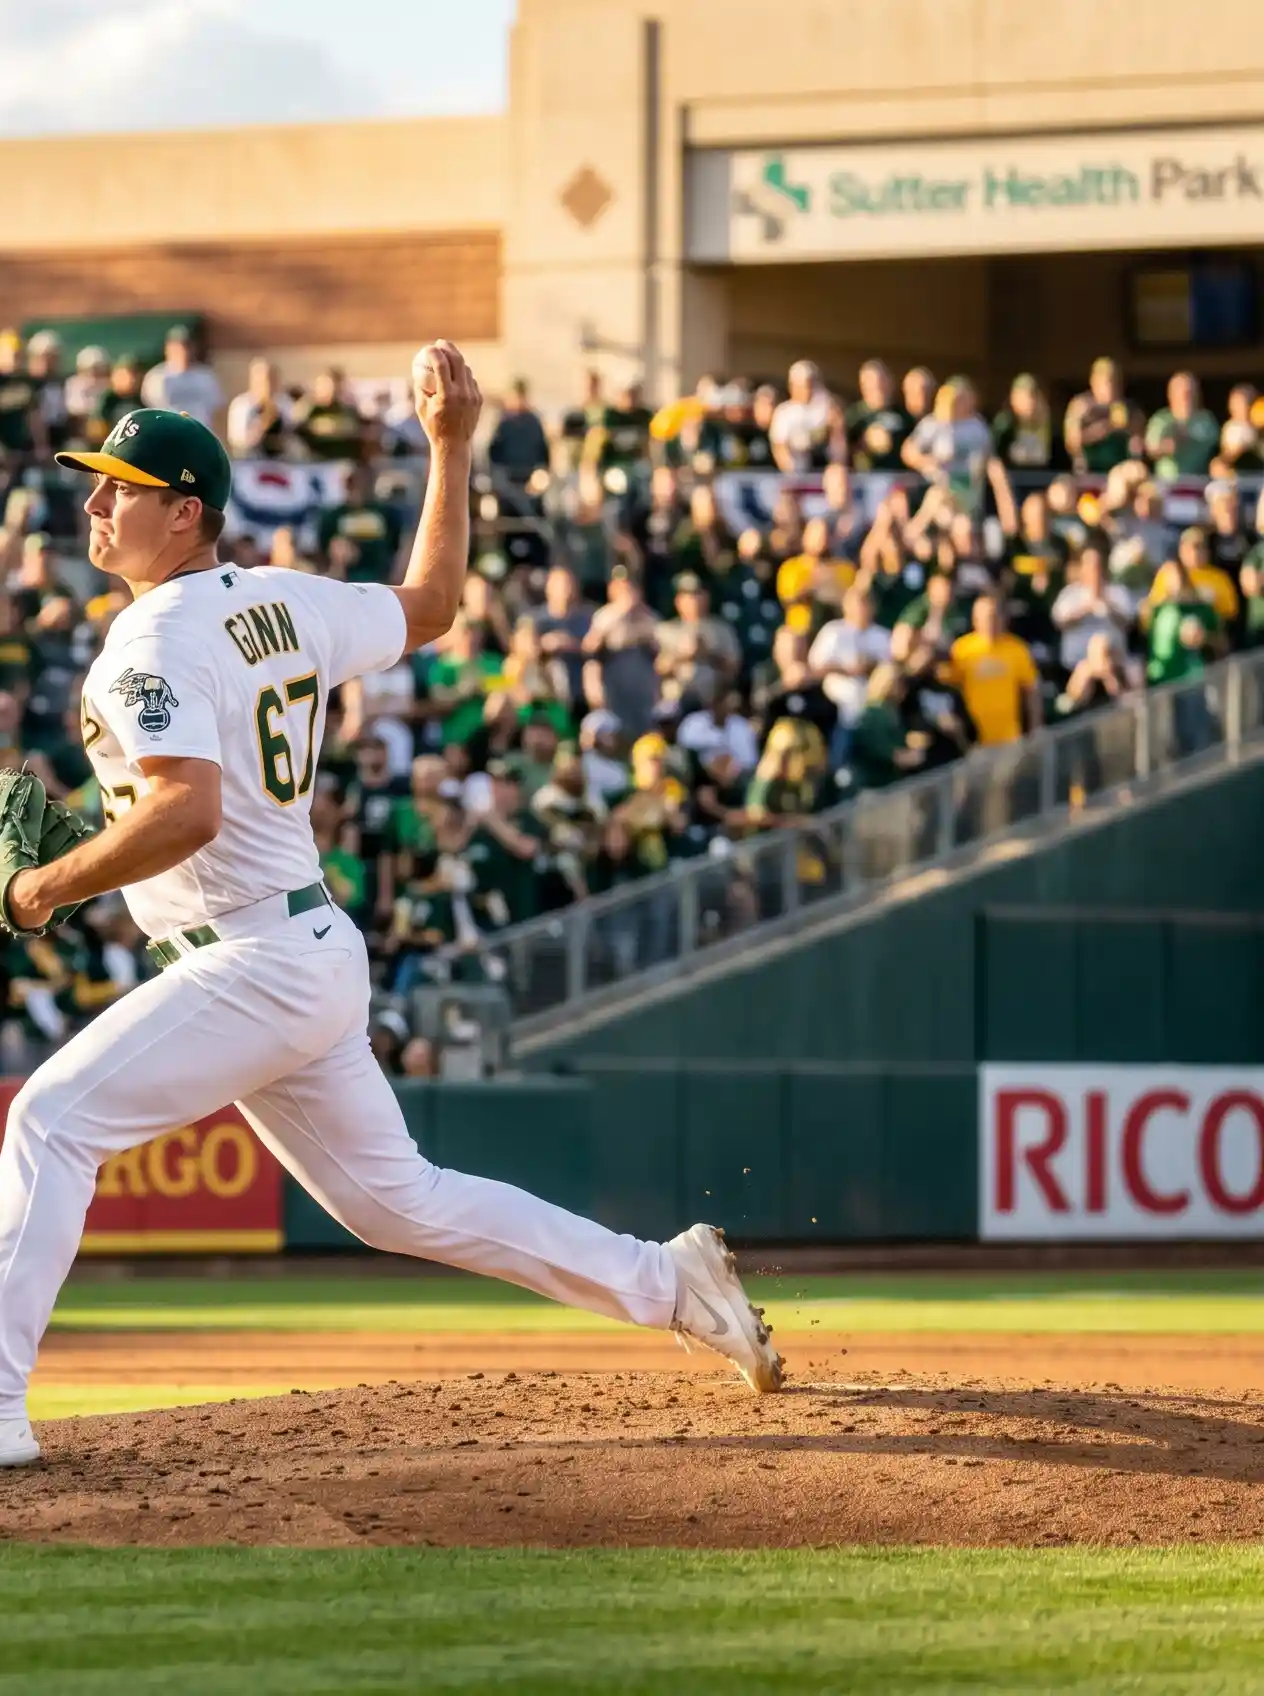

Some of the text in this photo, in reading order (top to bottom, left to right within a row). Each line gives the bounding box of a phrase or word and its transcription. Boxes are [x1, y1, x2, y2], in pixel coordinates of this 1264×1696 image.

[827, 154, 1264, 216] Sutter Health Park
[224, 601, 301, 668] GINN
[253, 667, 319, 808] 67
[993, 1086, 1264, 1217] RICO
